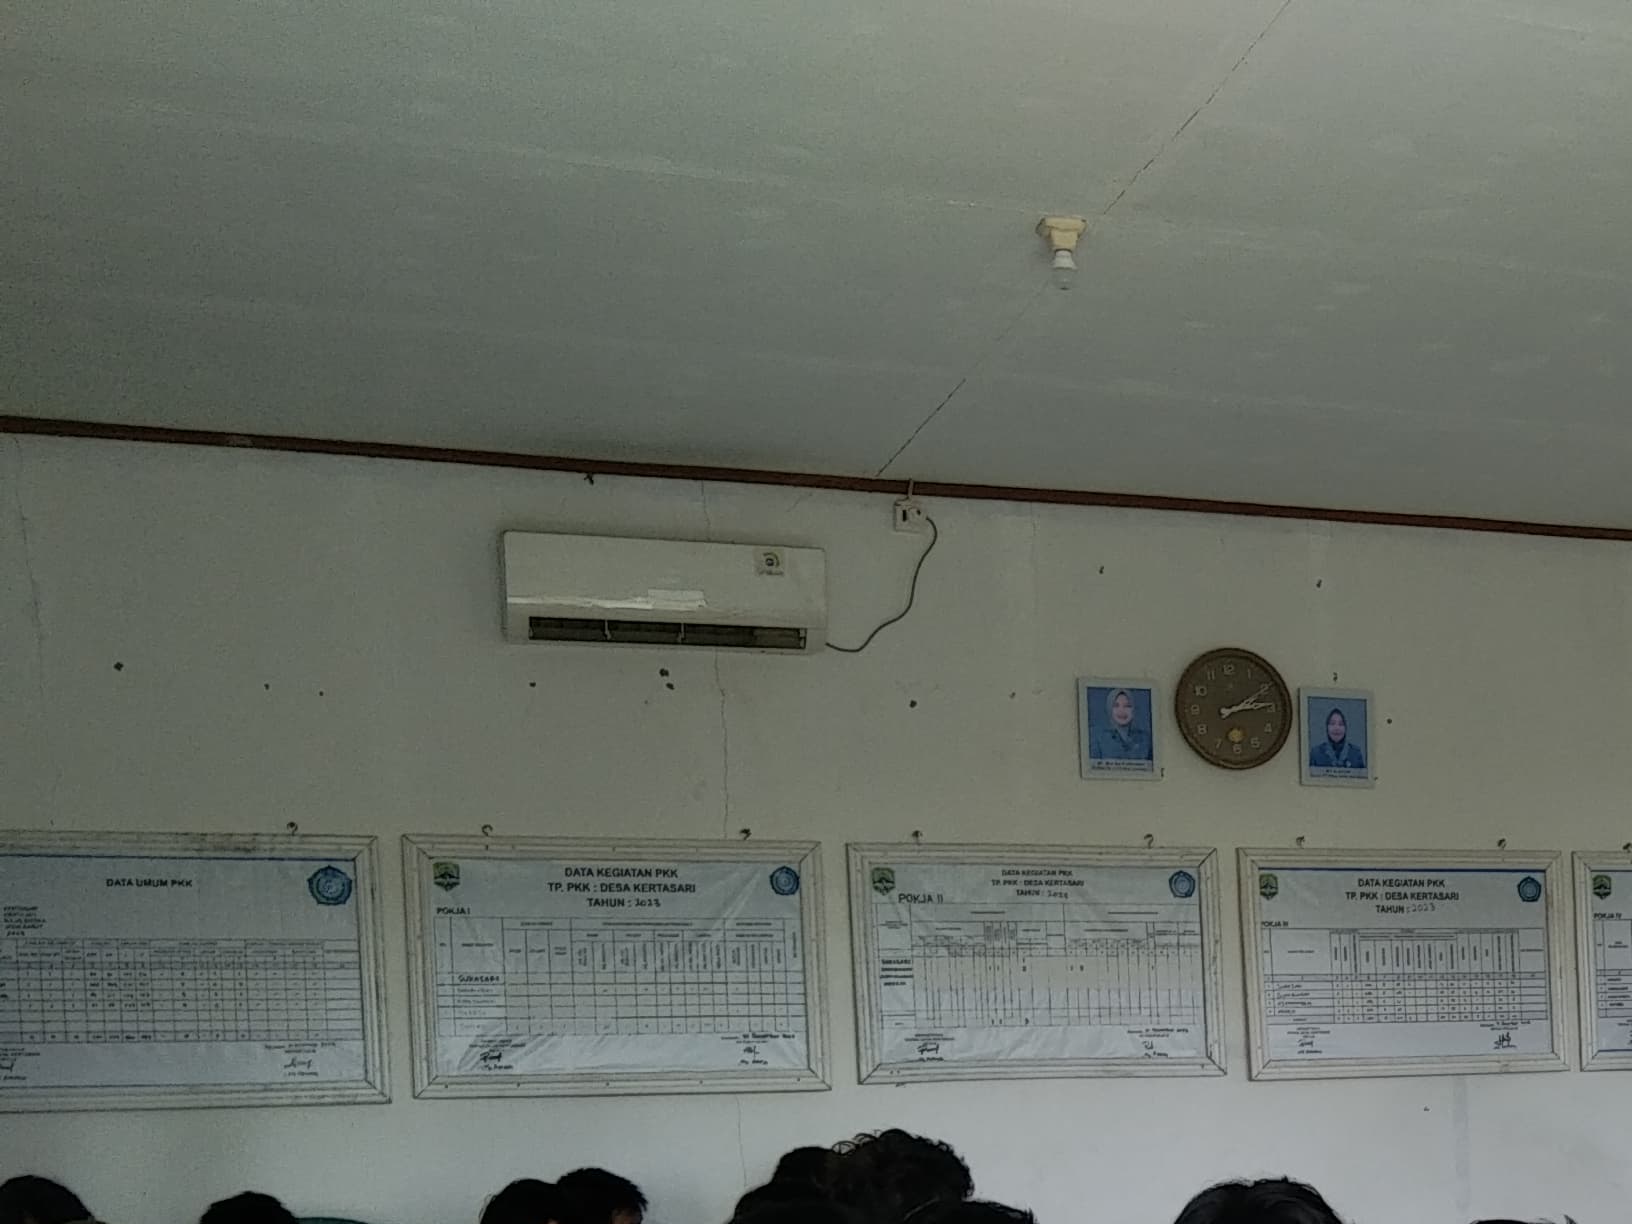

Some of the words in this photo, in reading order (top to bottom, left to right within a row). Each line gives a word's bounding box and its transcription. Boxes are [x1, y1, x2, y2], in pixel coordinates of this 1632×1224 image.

[564, 867, 594, 878] DATA
[596, 867, 653, 878] KEGIATAN
[655, 868, 678, 878] PKK
[105, 878, 134, 887] DATA
[135, 878, 168, 887] UMUM
[170, 879, 193, 887] PKK
[548, 882, 564, 892] TP.
[567, 883, 590, 893] PKK
[600, 883, 631, 893] DESA
[633, 883, 696, 893] KERTASARI
[1358, 879, 1381, 888] DATA
[1382, 879, 1425, 888] KEGIATAN
[1427, 879, 1445, 888] PKK
[1360, 892, 1378, 900] PKK
[1385, 892, 1408, 900] DESA
[1410, 892, 1459, 901] KERTASARI
[587, 897, 625, 908] TAHUN
[1376, 904, 1404, 914] TAHUN
